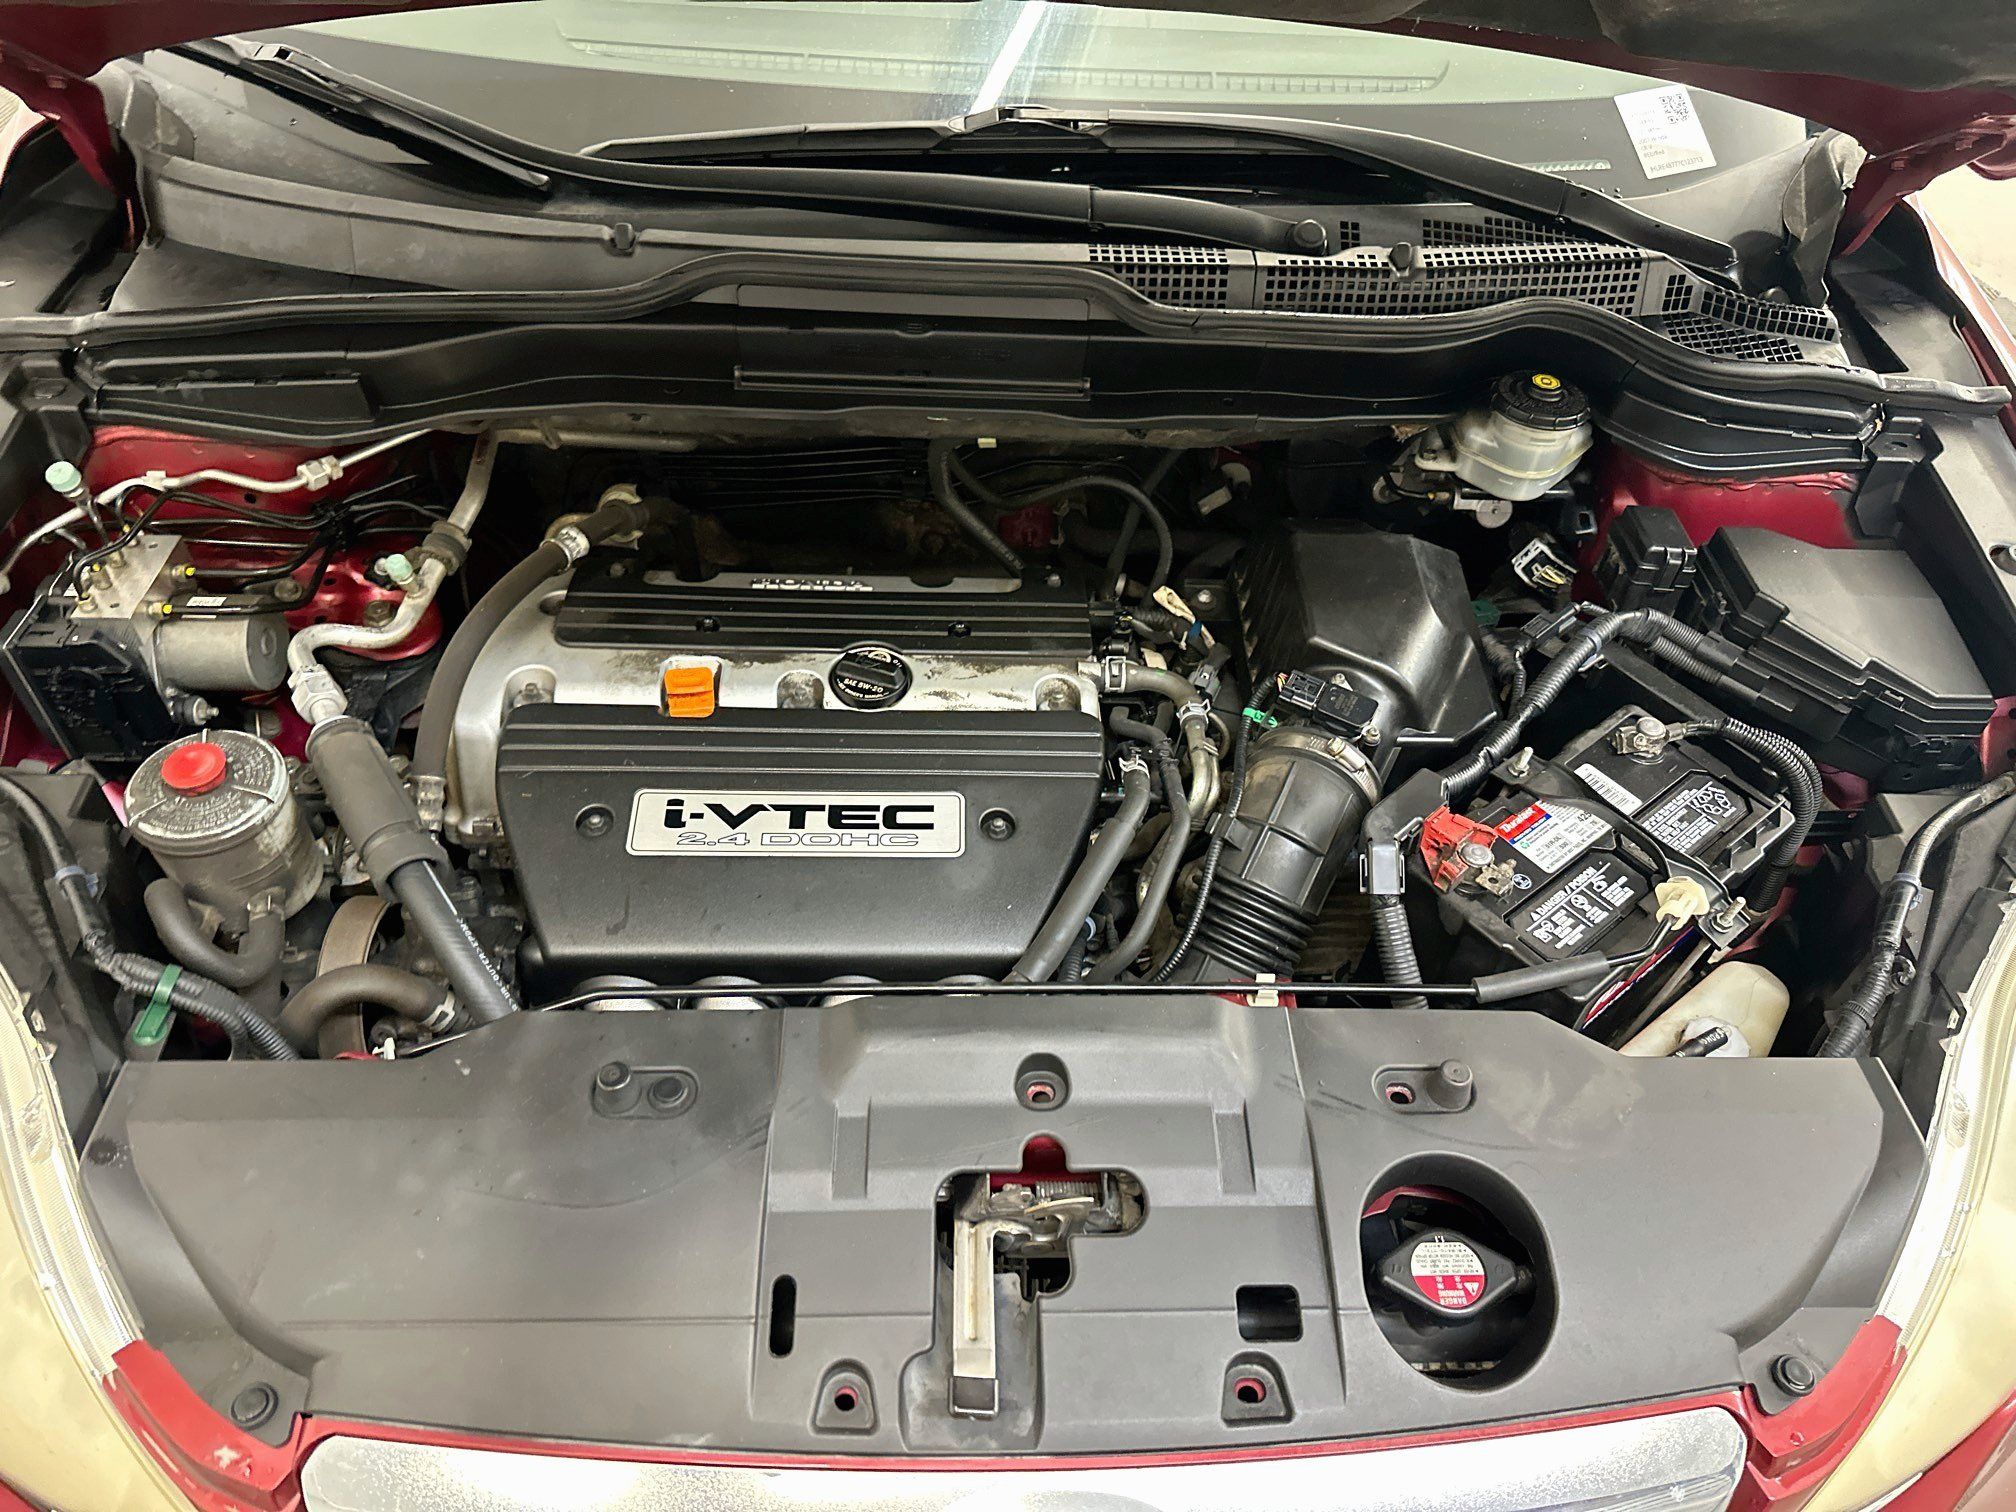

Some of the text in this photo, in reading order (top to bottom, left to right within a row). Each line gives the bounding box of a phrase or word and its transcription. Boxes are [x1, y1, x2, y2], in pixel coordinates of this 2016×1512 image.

[843, 678, 858, 687] SAE
[663, 798, 935, 830] i-VTEC
[1577, 810, 1592, 822] 425
[676, 832, 919, 847] 2.4 DOHC
[1535, 889, 1569, 916] DANGER
[1439, 1297, 1468, 1306] DANGER
